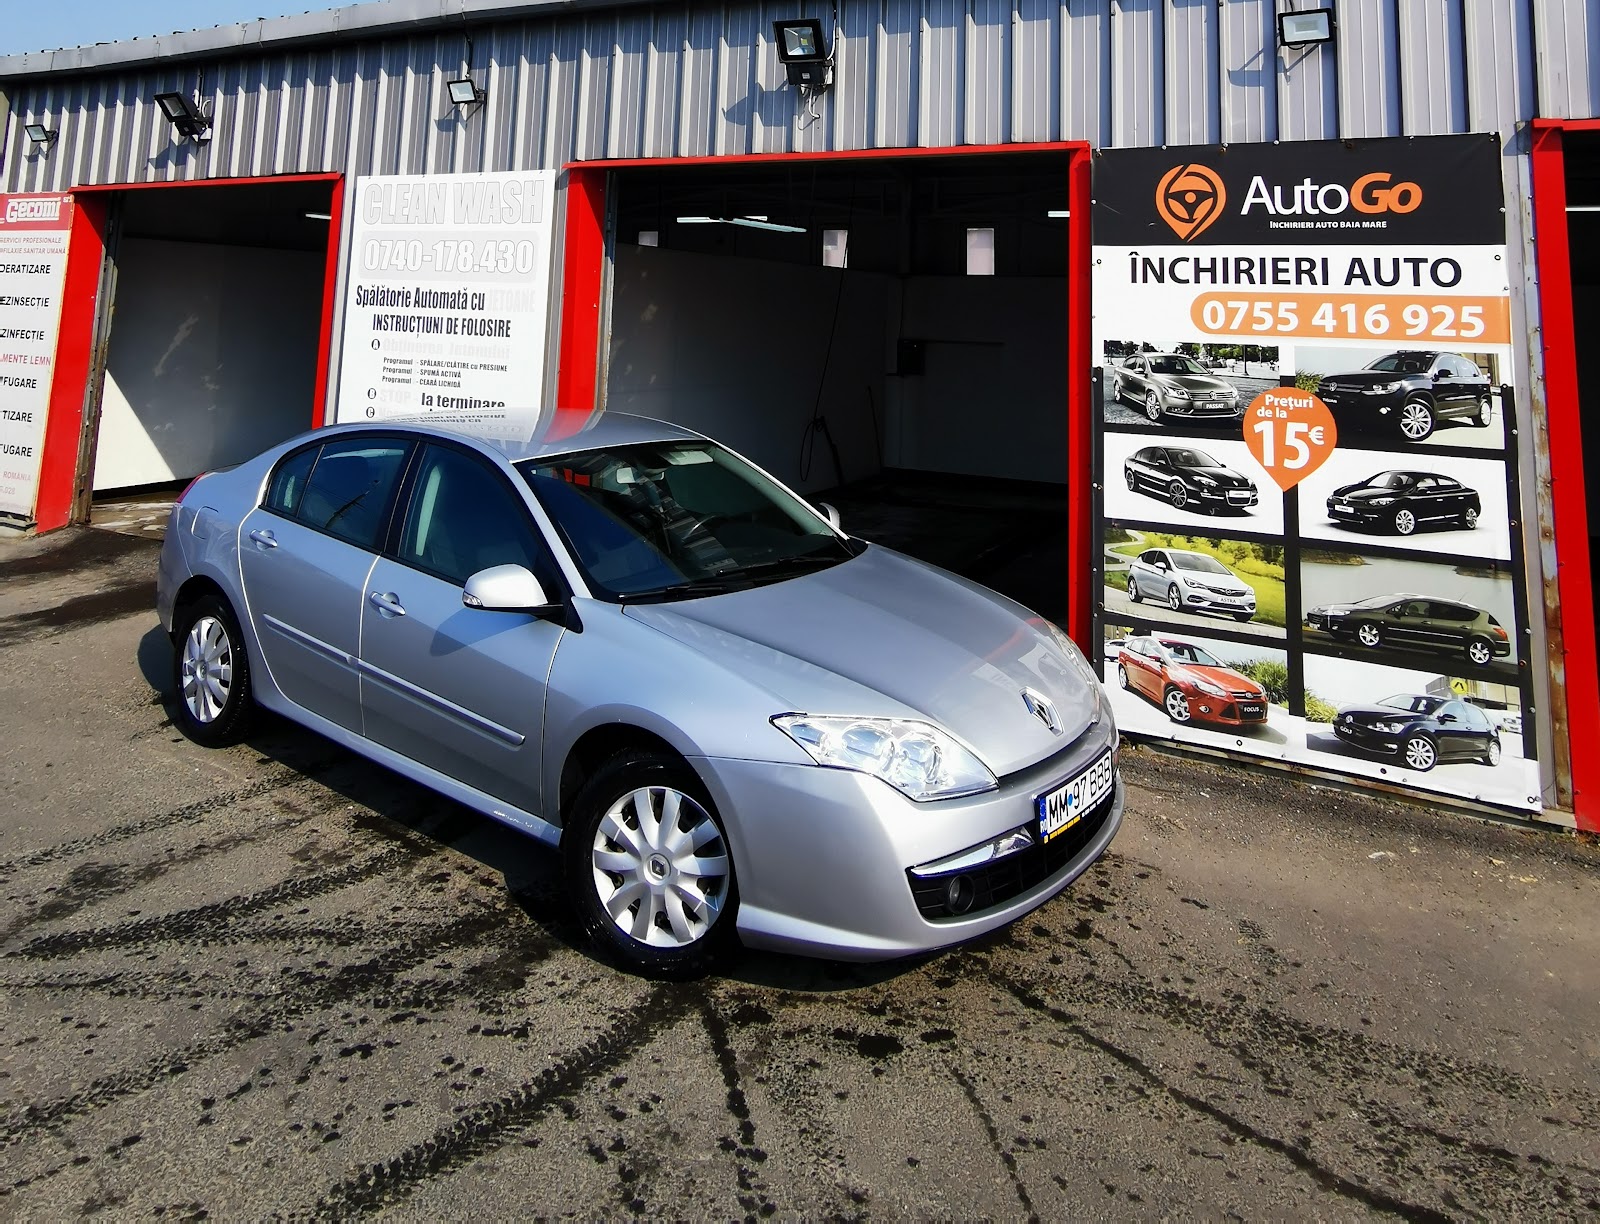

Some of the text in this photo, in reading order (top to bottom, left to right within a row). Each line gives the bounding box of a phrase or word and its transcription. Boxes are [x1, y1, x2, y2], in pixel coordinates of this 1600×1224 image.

[363, 180, 544, 225] CLEAN WASH
[1240, 172, 1422, 216] AutoGo
[1270, 220, 1314, 228] ÎNCHIRIERI
[1362, 220, 1387, 228] MARE
[364, 239, 534, 274] 0740-178.430
[1128, 251, 1462, 288] ÎNCHIRIERI AUTO
[356, 284, 411, 308] Spălătorie
[414, 287, 468, 310] Automată
[471, 292, 485, 311] cu
[446, 317, 459, 335] DE
[461, 318, 511, 337] FOLOSIRE
[1203, 300, 1485, 337] 0755 416 925
[382, 366, 412, 375] Programul
[383, 357, 413, 366] Programul
[479, 363, 508, 372] PRESIUNE
[381, 375, 412, 384] Programul
[421, 392, 434, 407] la
[1256, 406, 1288, 418] de la
[1049, 788, 1069, 828] MM
[1073, 775, 1087, 809] 97
[1089, 756, 1111, 799] BBB
